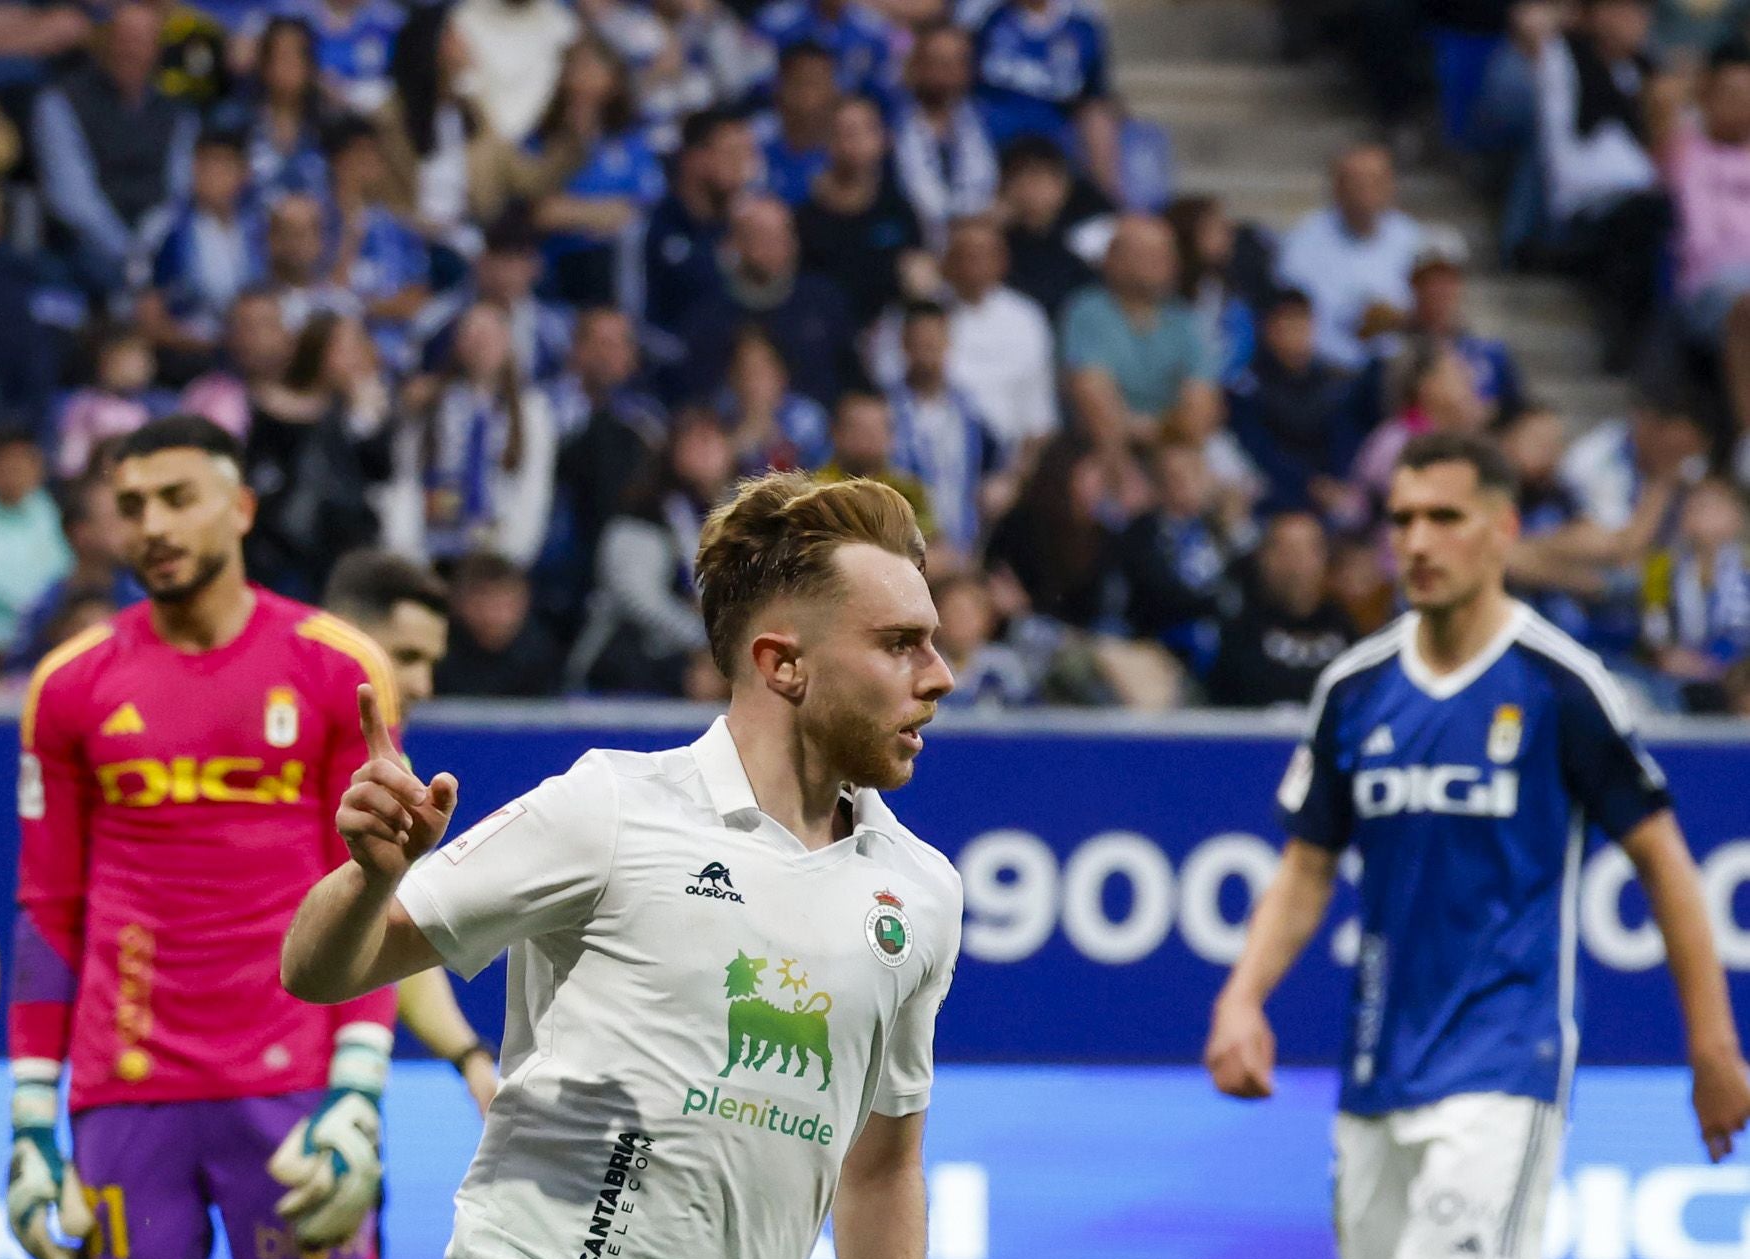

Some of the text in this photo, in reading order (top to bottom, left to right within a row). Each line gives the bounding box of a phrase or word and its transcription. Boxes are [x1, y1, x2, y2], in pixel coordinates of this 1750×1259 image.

[96, 757, 305, 807] DIGI
[1353, 764, 1520, 819] DIGI
[685, 884, 746, 904] austral
[958, 828, 1280, 966] 900
[683, 1084, 834, 1145] plenitude
